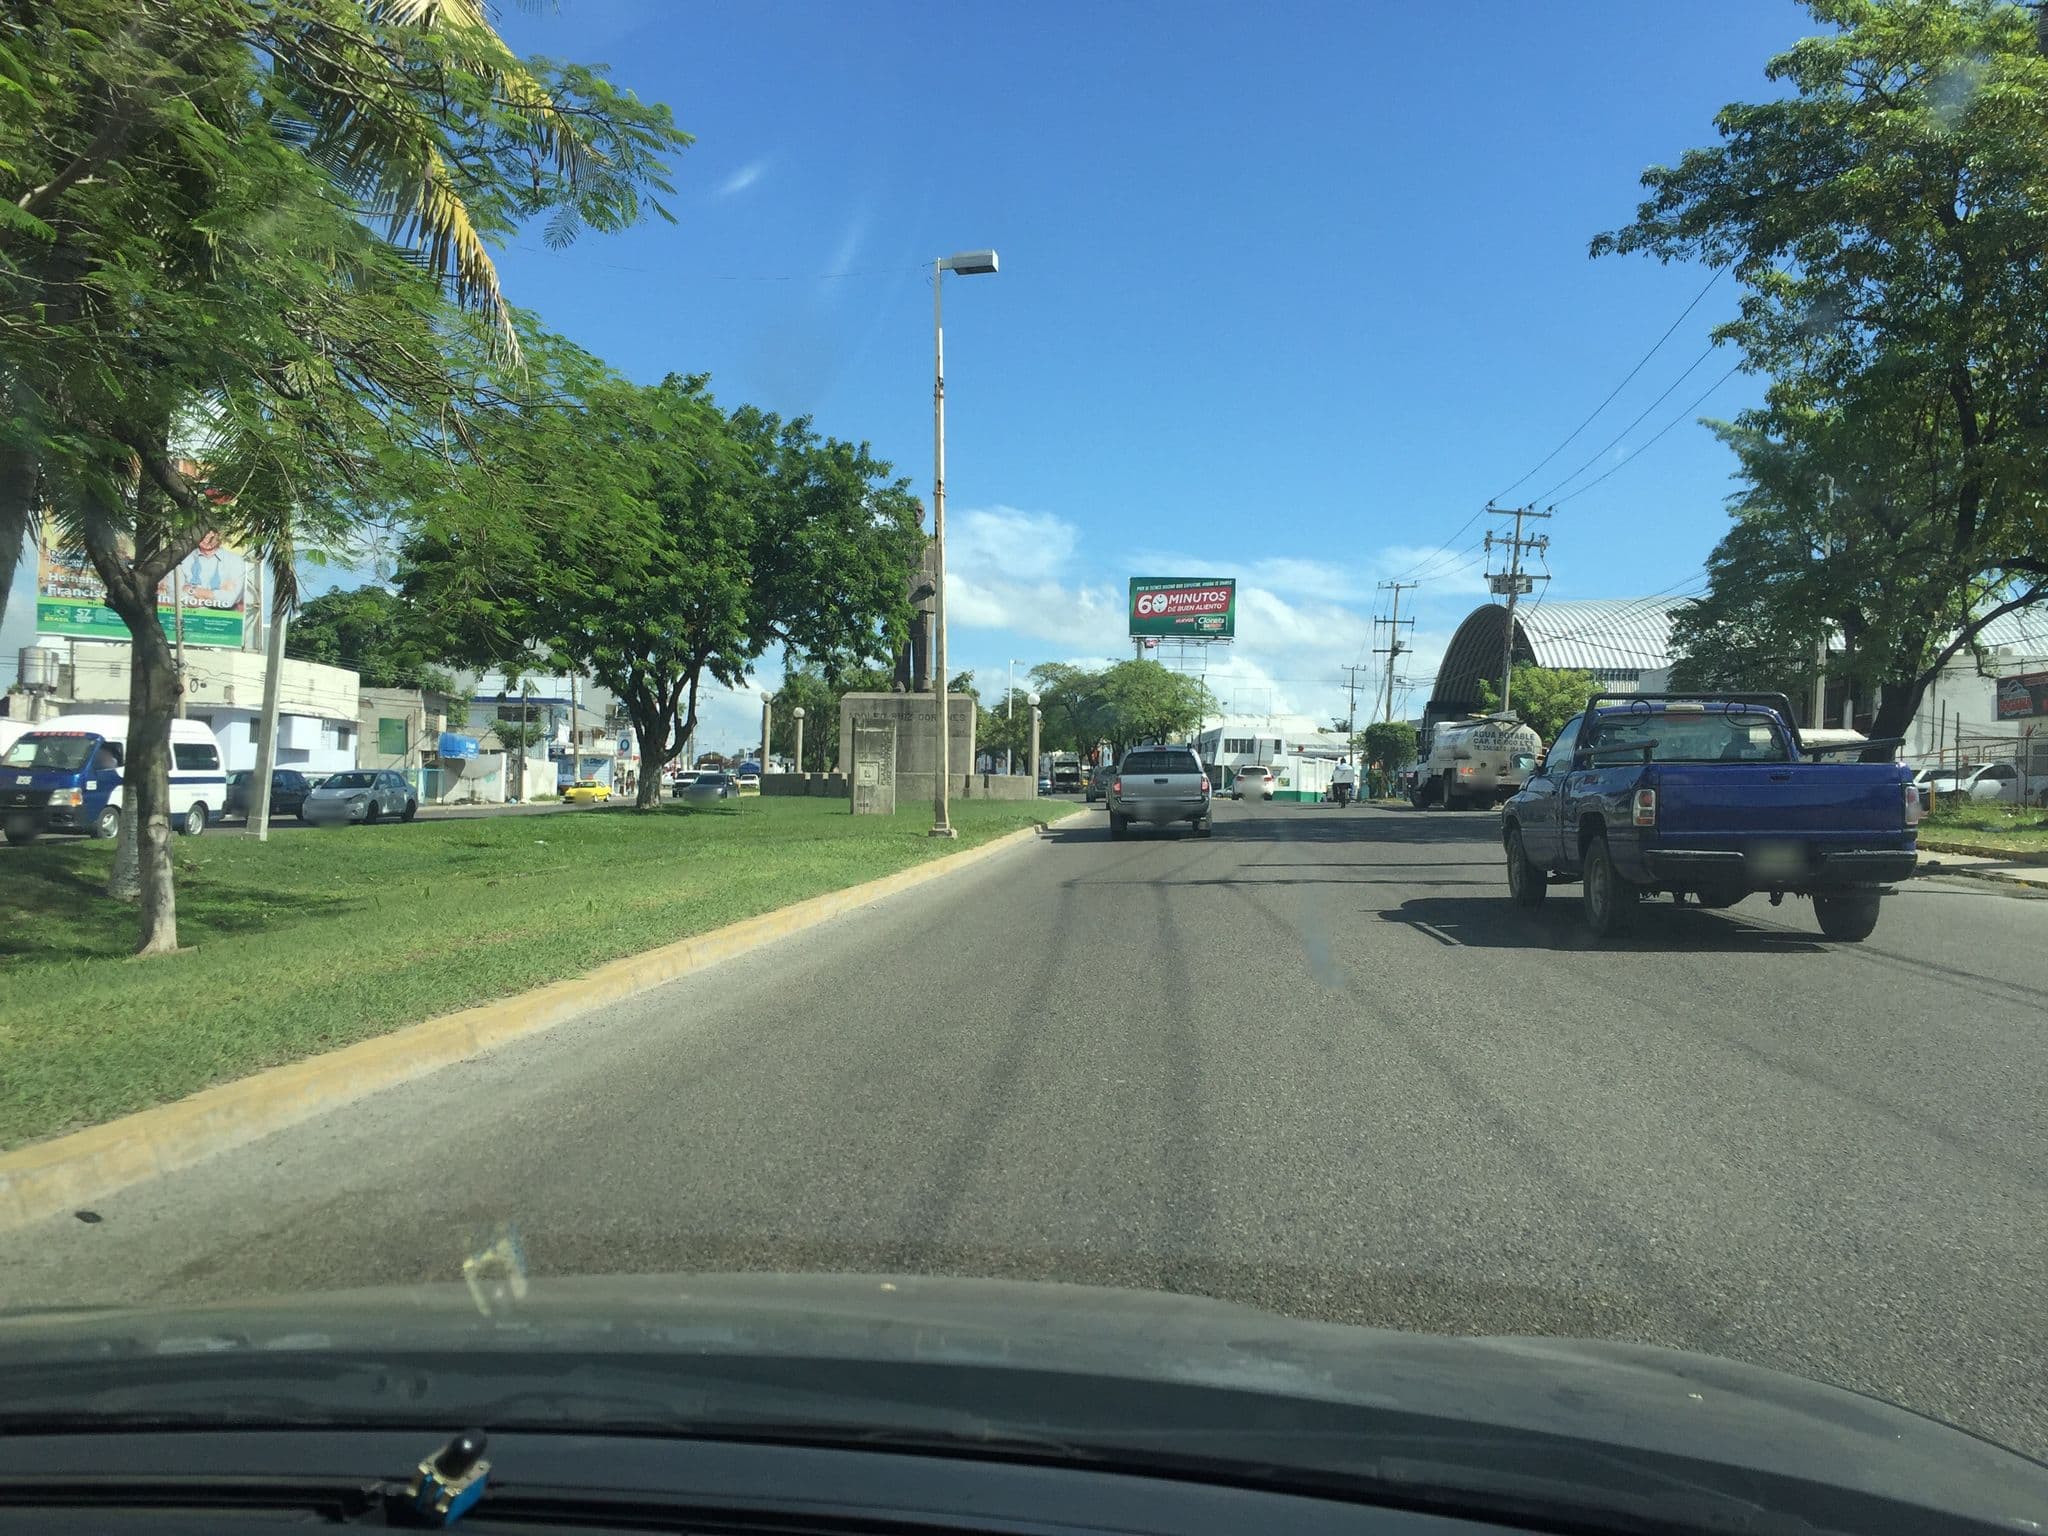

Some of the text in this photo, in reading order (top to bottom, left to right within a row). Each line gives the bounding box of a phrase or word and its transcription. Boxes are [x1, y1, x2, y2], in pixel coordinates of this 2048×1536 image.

[47, 584, 108, 599] Francisc
[1169, 591, 1227, 605] MINUTOS
[1177, 604, 1194, 612] BUEN
[1195, 602, 1222, 611] ALIENTO
[1498, 731, 1535, 740] POTABLE
